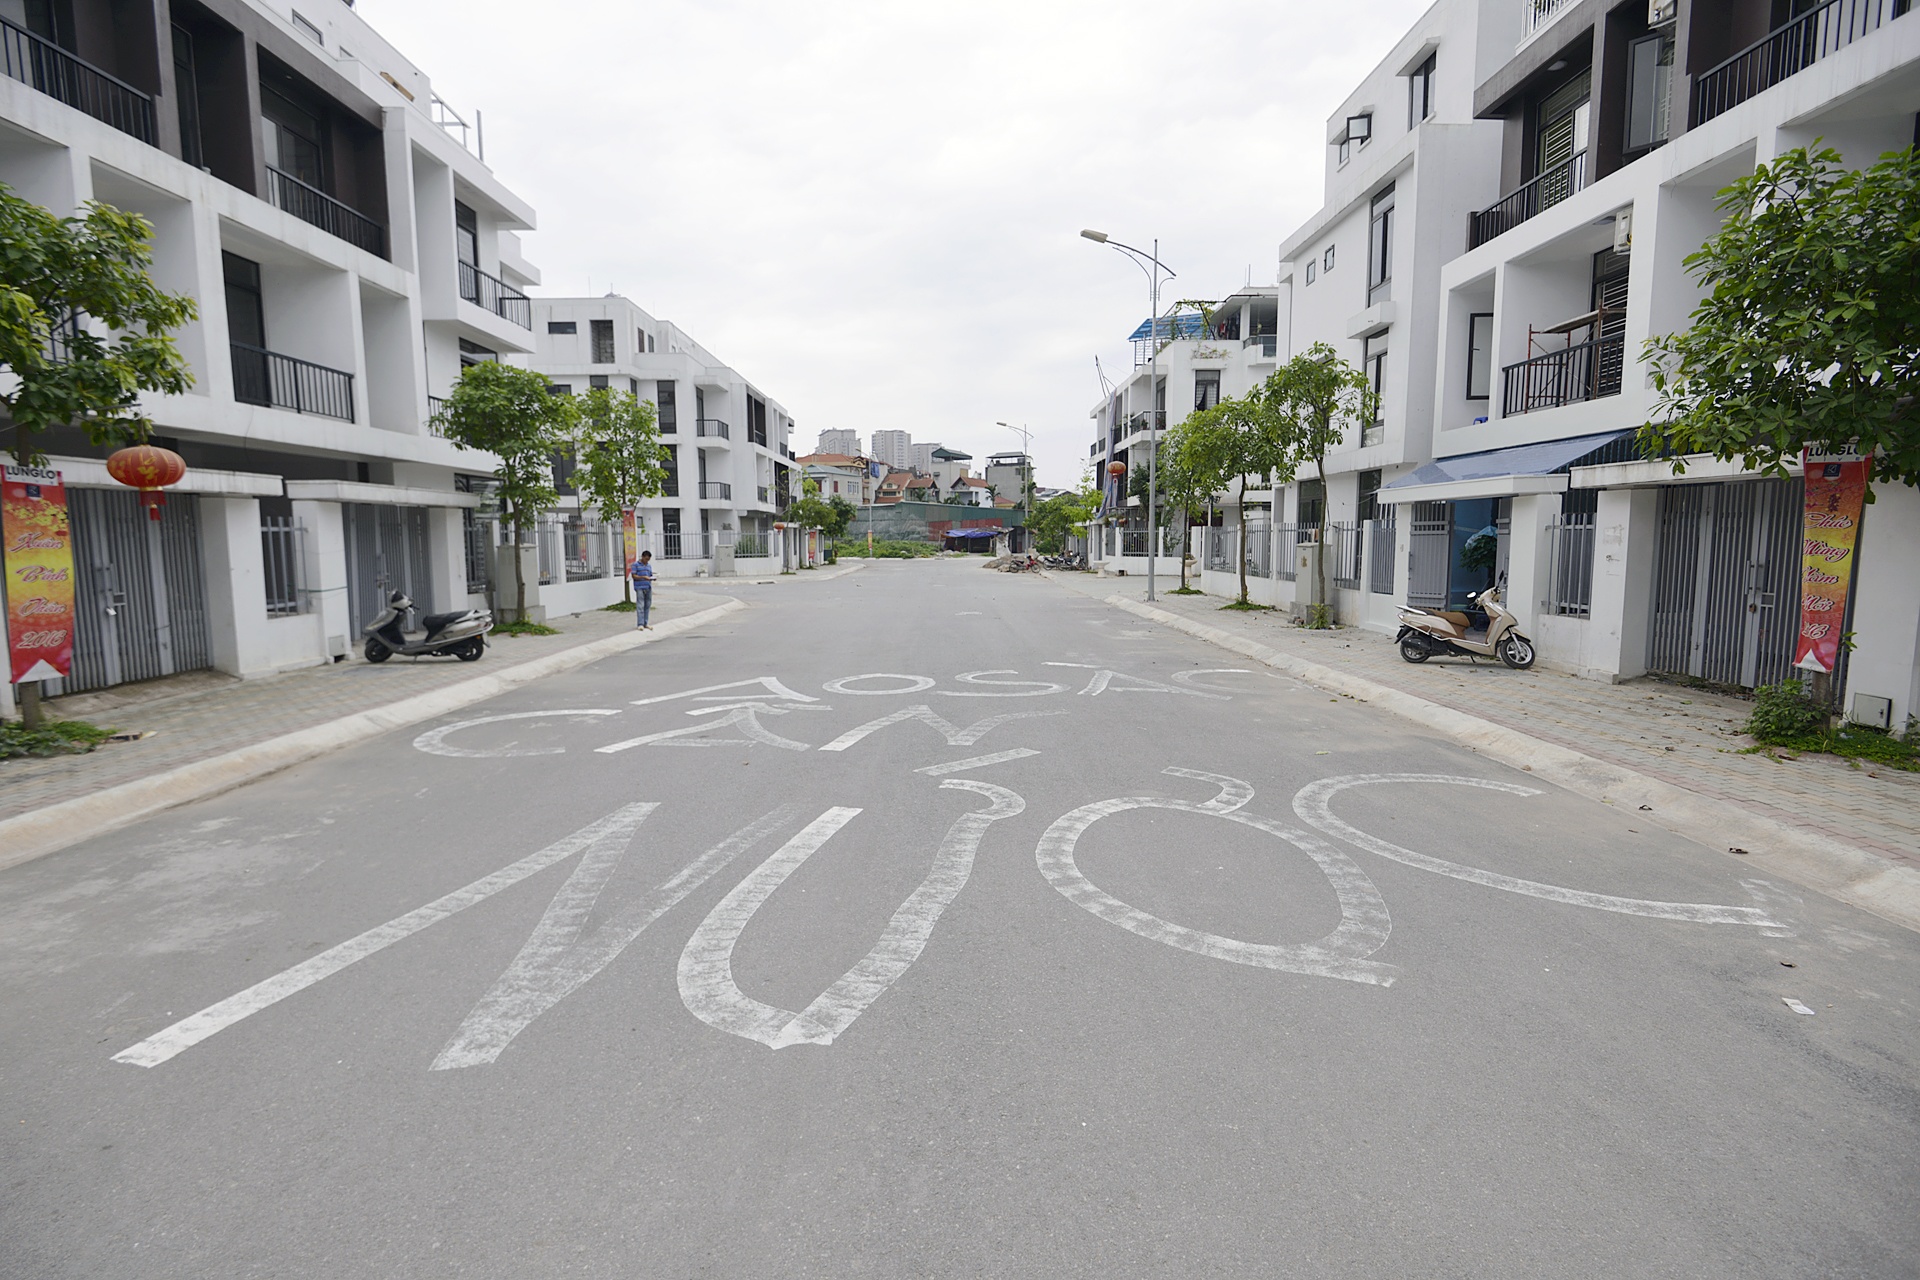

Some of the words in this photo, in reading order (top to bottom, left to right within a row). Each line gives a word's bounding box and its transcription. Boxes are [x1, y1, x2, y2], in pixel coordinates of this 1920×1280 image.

[6, 466, 56, 480] LUNGLO
[1804, 511, 1853, 530] Chúc
[8, 531, 64, 553] Xuân
[16, 565, 69, 583] Bính
[18, 596, 67, 617] Thân
[16, 629, 68, 649] 2016
[629, 675, 937, 706] AO
[412, 701, 1071, 758] CẦN
[111, 747, 1792, 1071] NƯỚC
